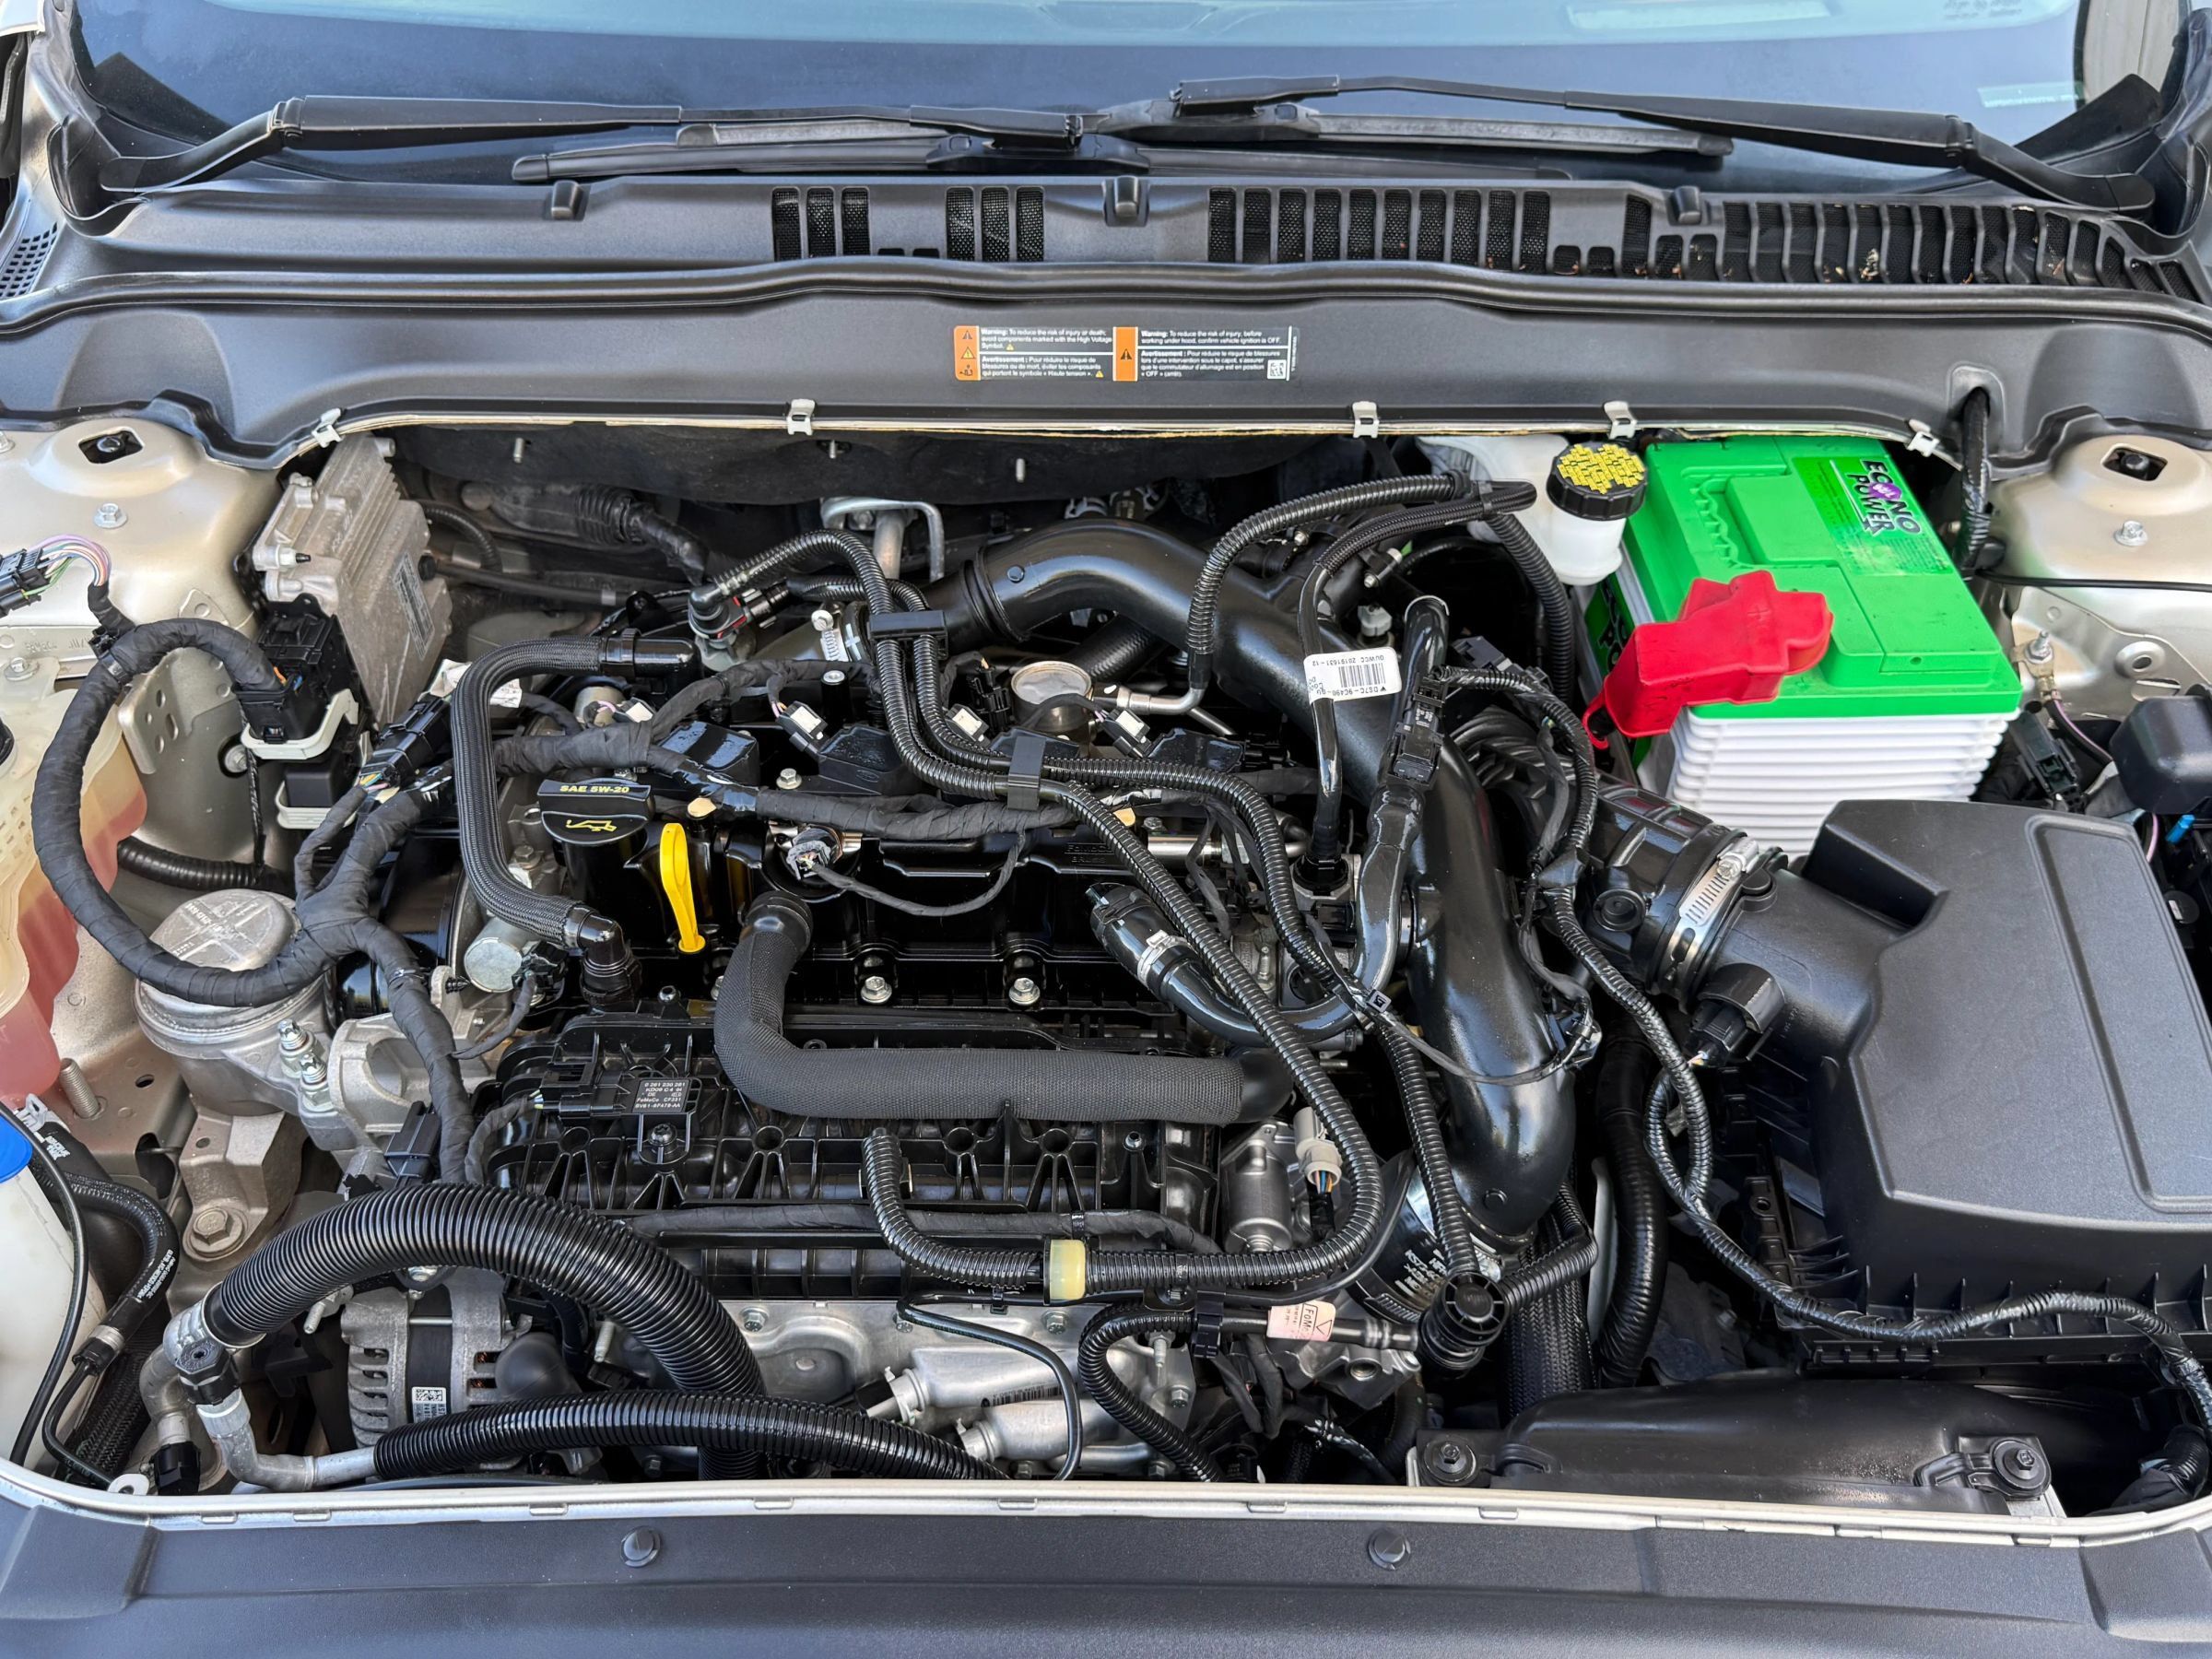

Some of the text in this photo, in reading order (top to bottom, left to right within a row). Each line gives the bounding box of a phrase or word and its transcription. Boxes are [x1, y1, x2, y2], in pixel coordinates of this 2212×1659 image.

[981, 328, 1007, 336] Warning:
[1065, 328, 1080, 337] injury
[1141, 330, 1169, 338] Warning:
[590, 785, 629, 794] 5W-20
